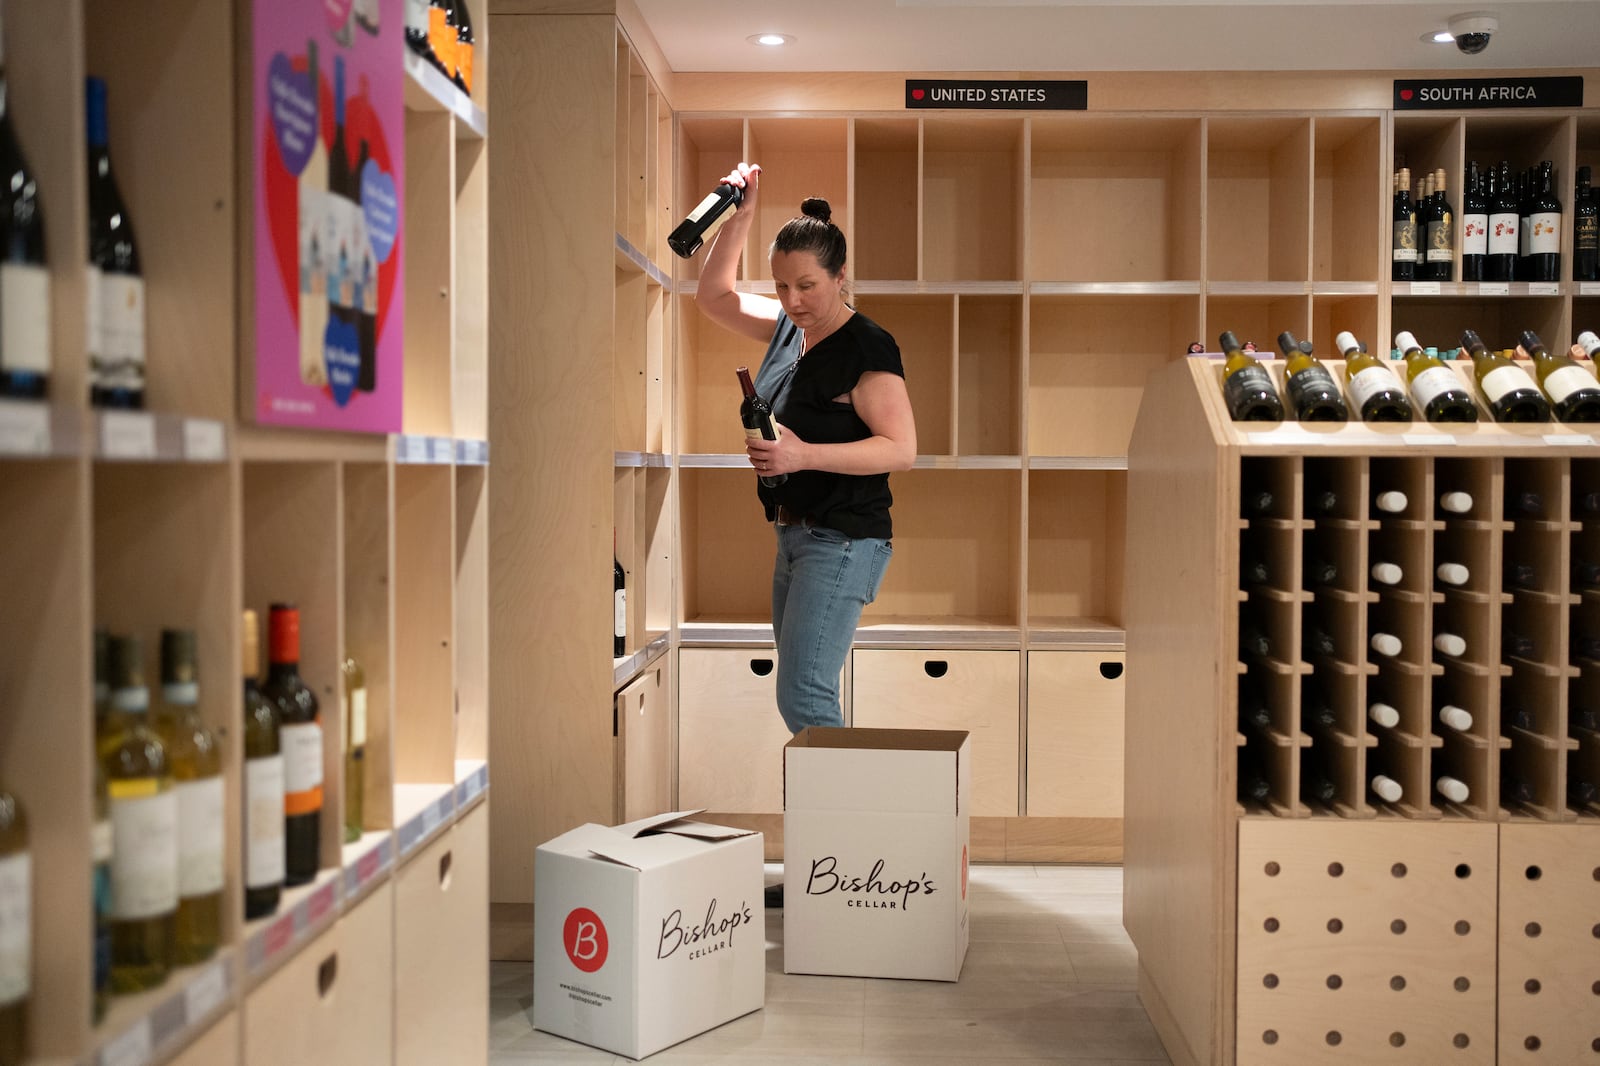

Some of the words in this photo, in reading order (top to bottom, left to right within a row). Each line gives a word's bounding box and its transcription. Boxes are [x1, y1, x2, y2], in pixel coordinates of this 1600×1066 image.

[931, 88, 987, 102] UNITED
[990, 88, 1046, 102] STATES
[1420, 86, 1473, 101] SOUTH
[1478, 86, 1536, 101] AFRICA
[806, 856, 937, 910] Bishop's
[847, 899, 897, 909] CELLAR
[657, 898, 752, 960] Bishop's
[573, 921, 598, 960] B
[689, 941, 725, 960] CELLAR
